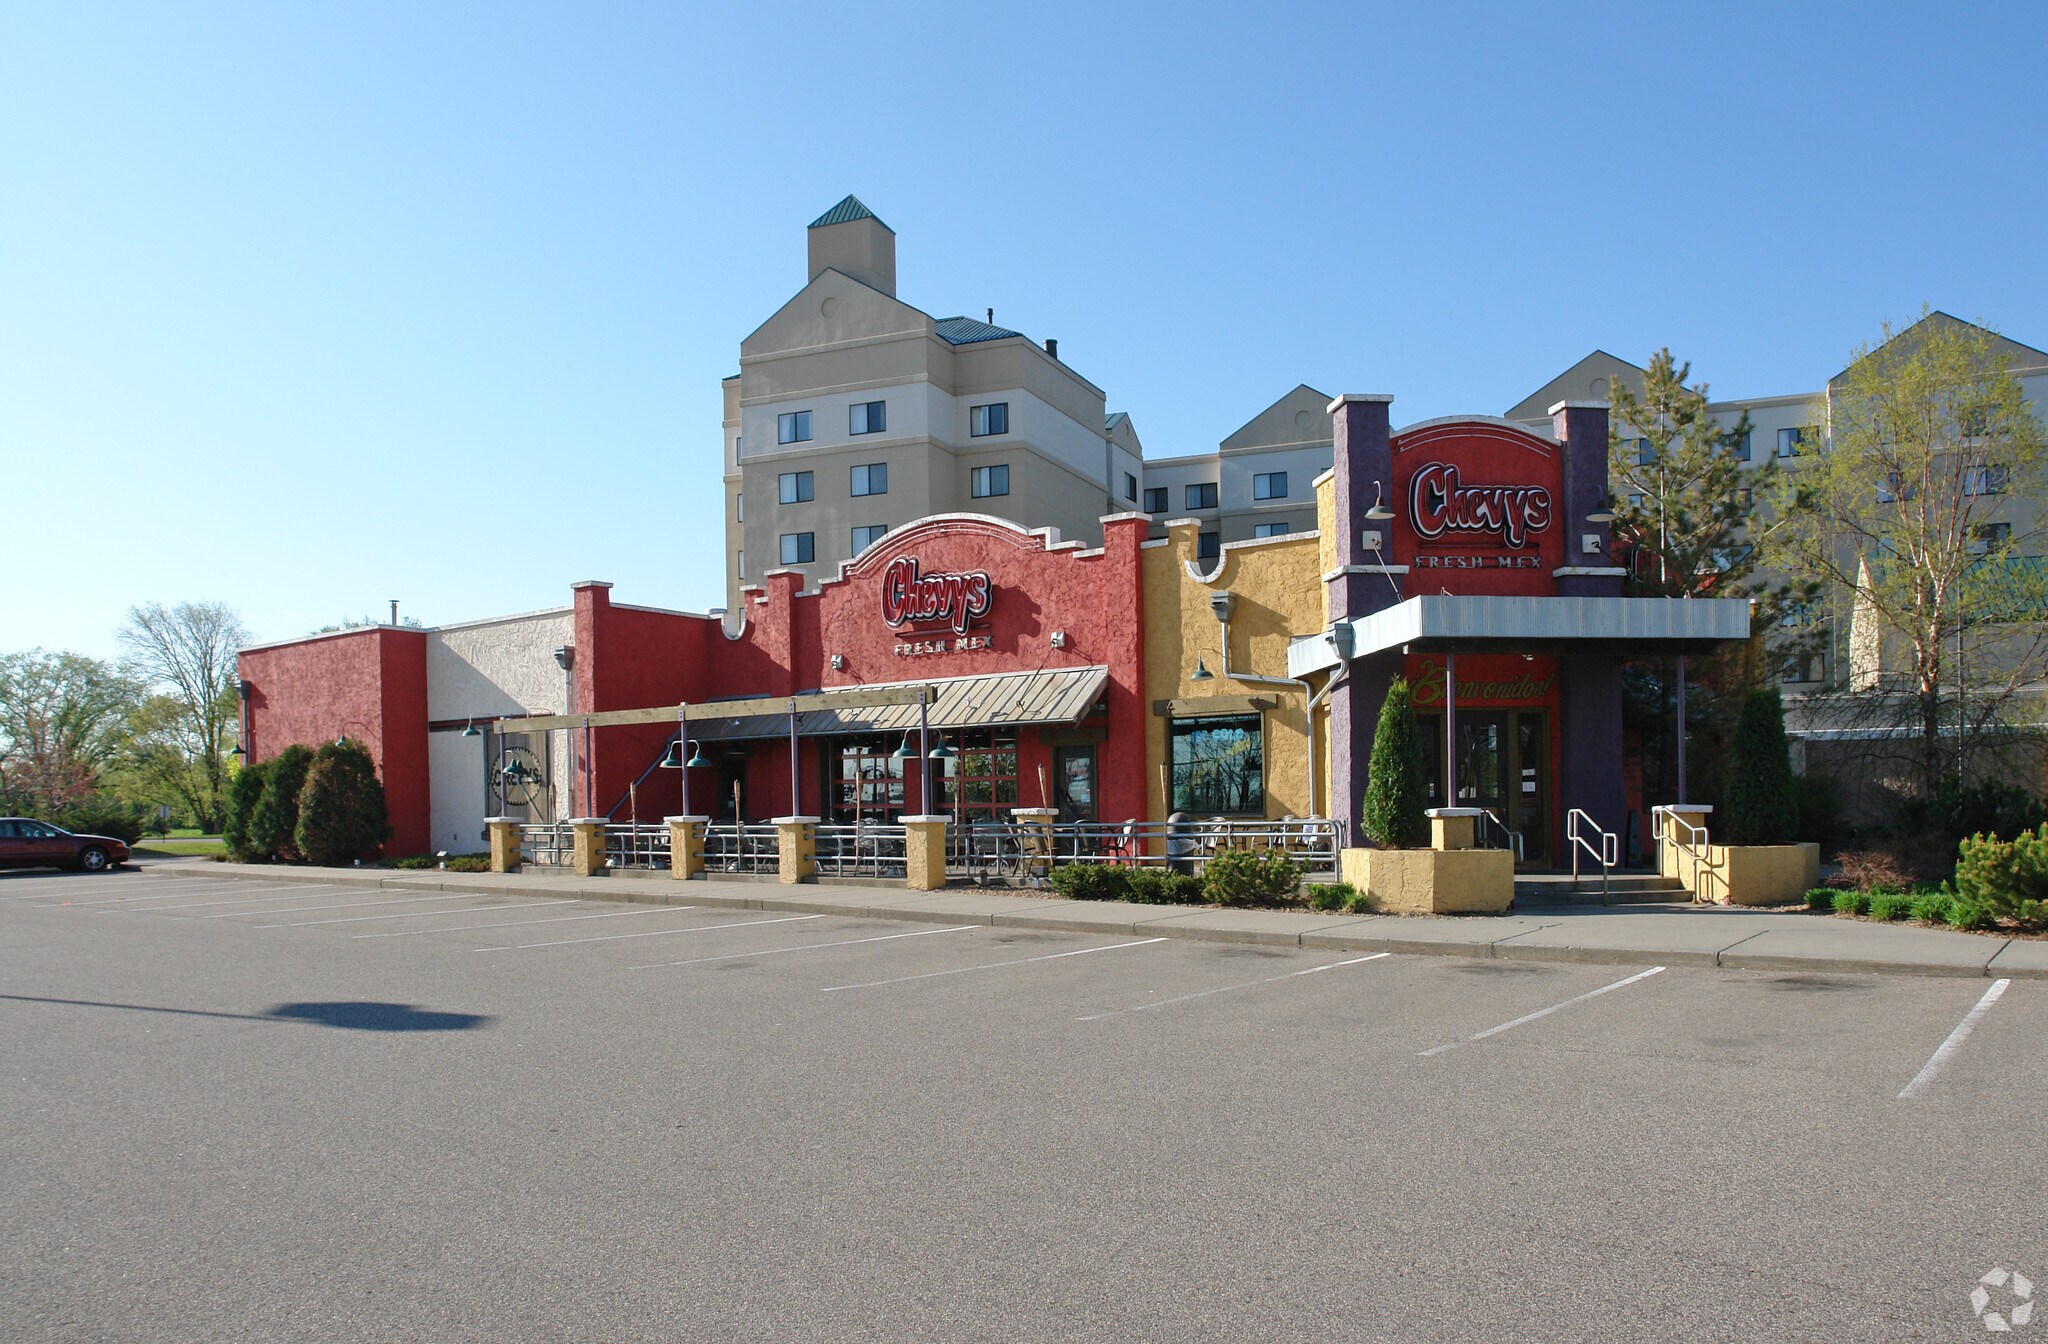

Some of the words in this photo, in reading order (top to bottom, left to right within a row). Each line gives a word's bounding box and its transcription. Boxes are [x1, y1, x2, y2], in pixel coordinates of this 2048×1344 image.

[1409, 463, 1551, 548] Chevys
[1414, 556, 1483, 568] FRESH
[1497, 556, 1542, 568] MEX
[882, 555, 991, 635] Chevys
[893, 640, 946, 657] FRESH
[955, 635, 993, 652] MEX
[494, 767, 542, 787] CEYS
